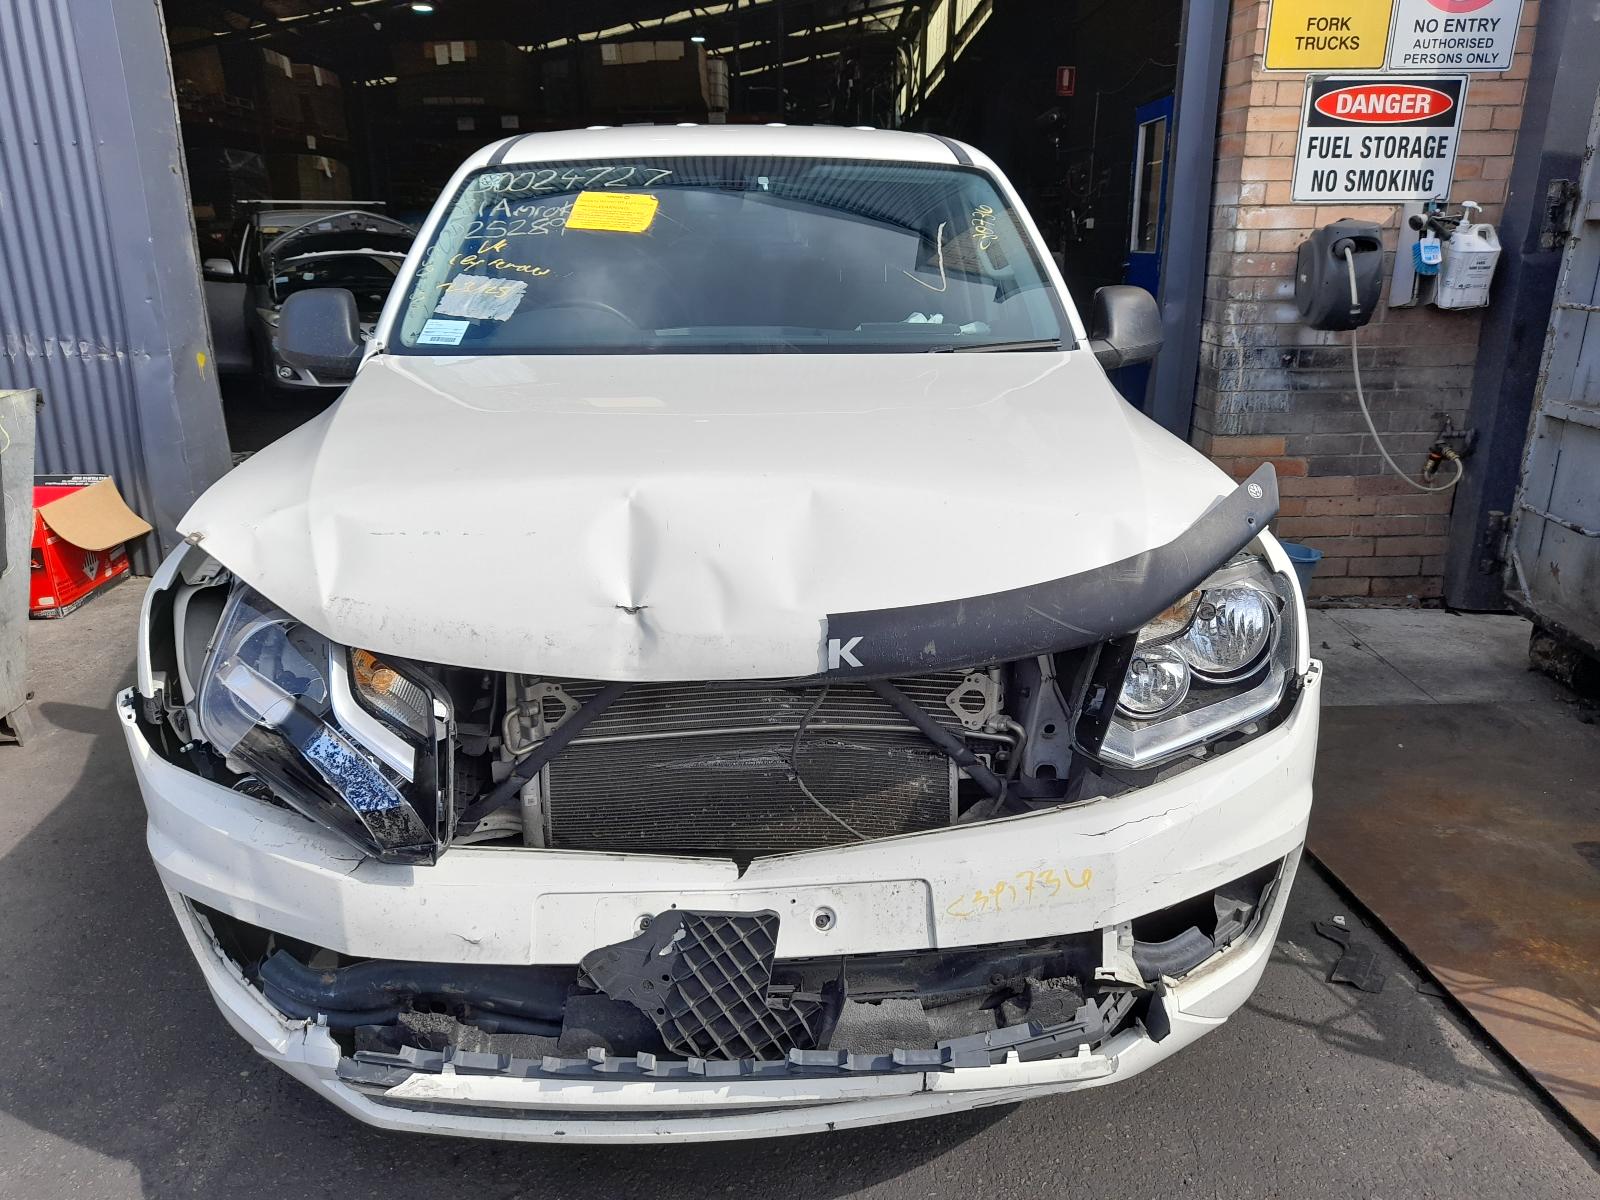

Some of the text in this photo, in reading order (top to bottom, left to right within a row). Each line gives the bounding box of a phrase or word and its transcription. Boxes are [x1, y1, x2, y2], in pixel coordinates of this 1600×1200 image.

[1306, 17, 1352, 32] FORK
[1413, 17, 1501, 33] NO ENTRY
[1295, 36, 1360, 51] TRUCKS
[1412, 38, 1494, 49] AUTHORISED
[1403, 53, 1500, 64] PERSONS ONLY
[1335, 93, 1431, 115] DANGER
[1306, 135, 1449, 159] FUEL STORAGE
[1310, 169, 1435, 193] NO SMOKING
[828, 636, 864, 670] K
